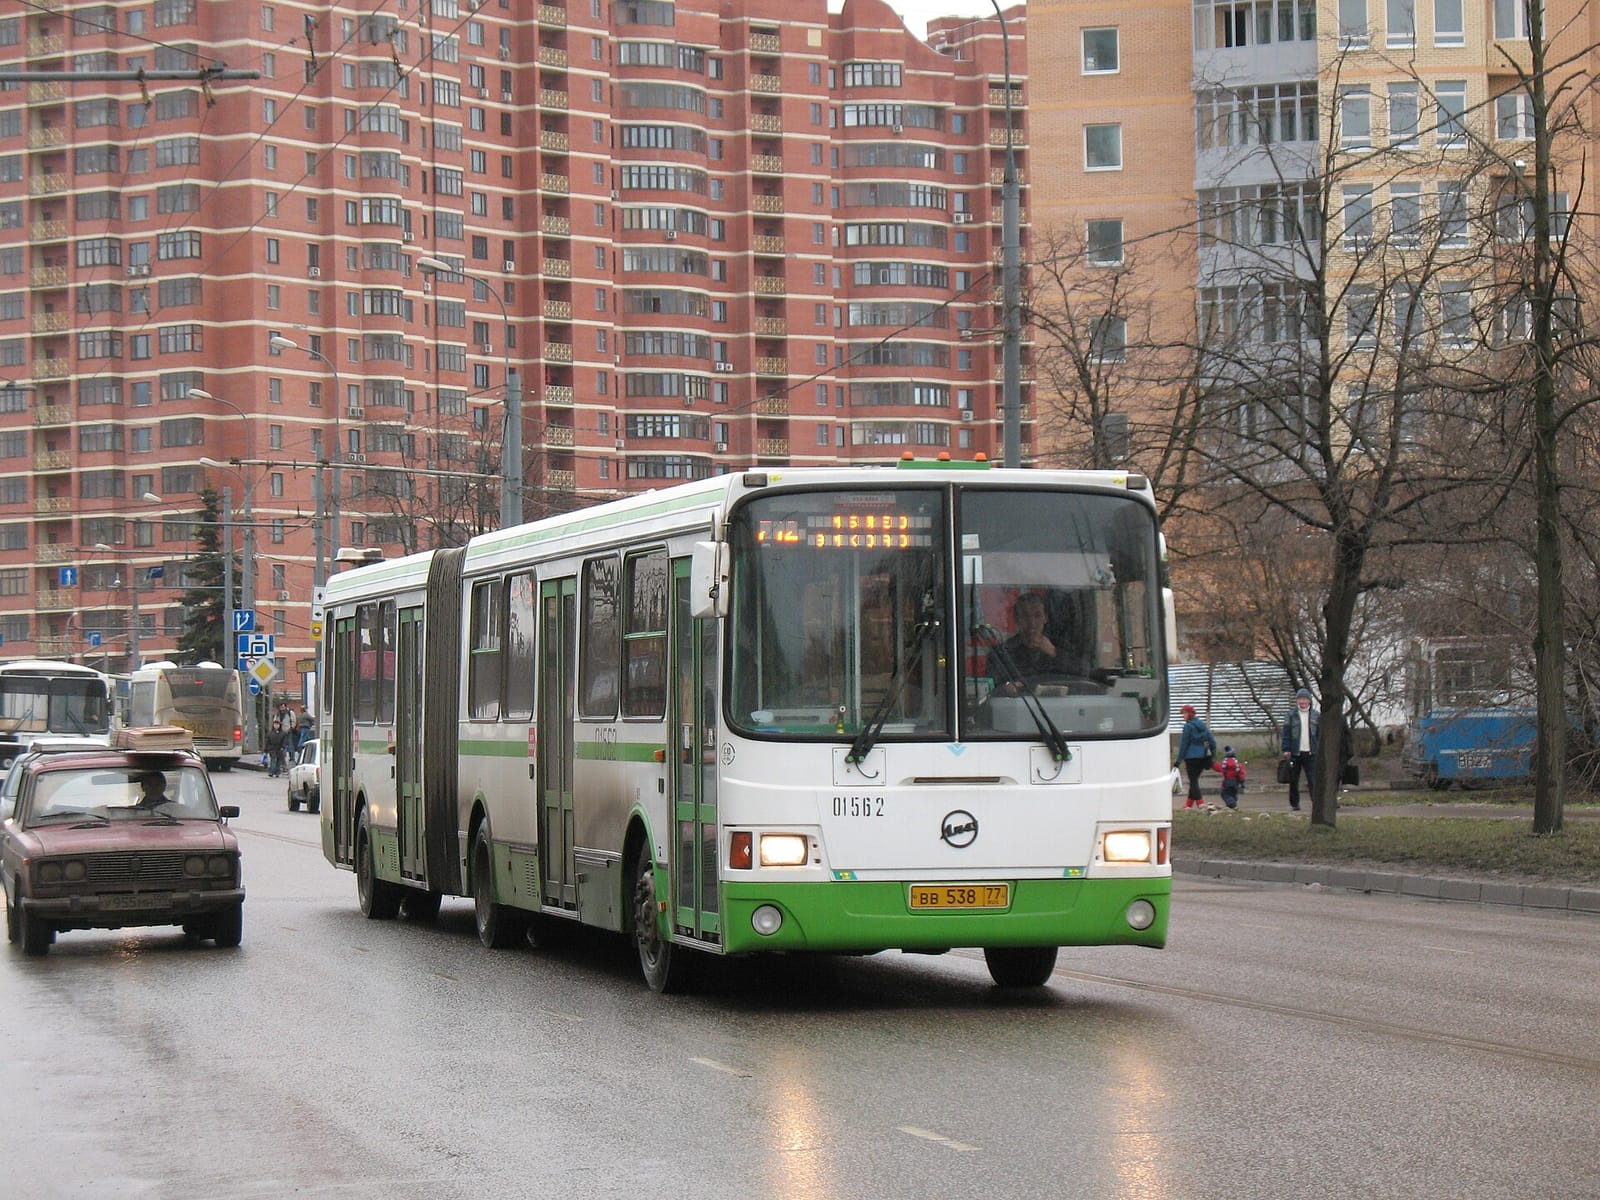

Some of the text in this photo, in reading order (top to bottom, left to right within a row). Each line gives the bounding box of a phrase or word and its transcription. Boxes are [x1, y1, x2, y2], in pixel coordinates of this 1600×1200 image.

[833, 796, 885, 817] 01562
[946, 889, 976, 904] 538
[986, 887, 1001, 900] 77
